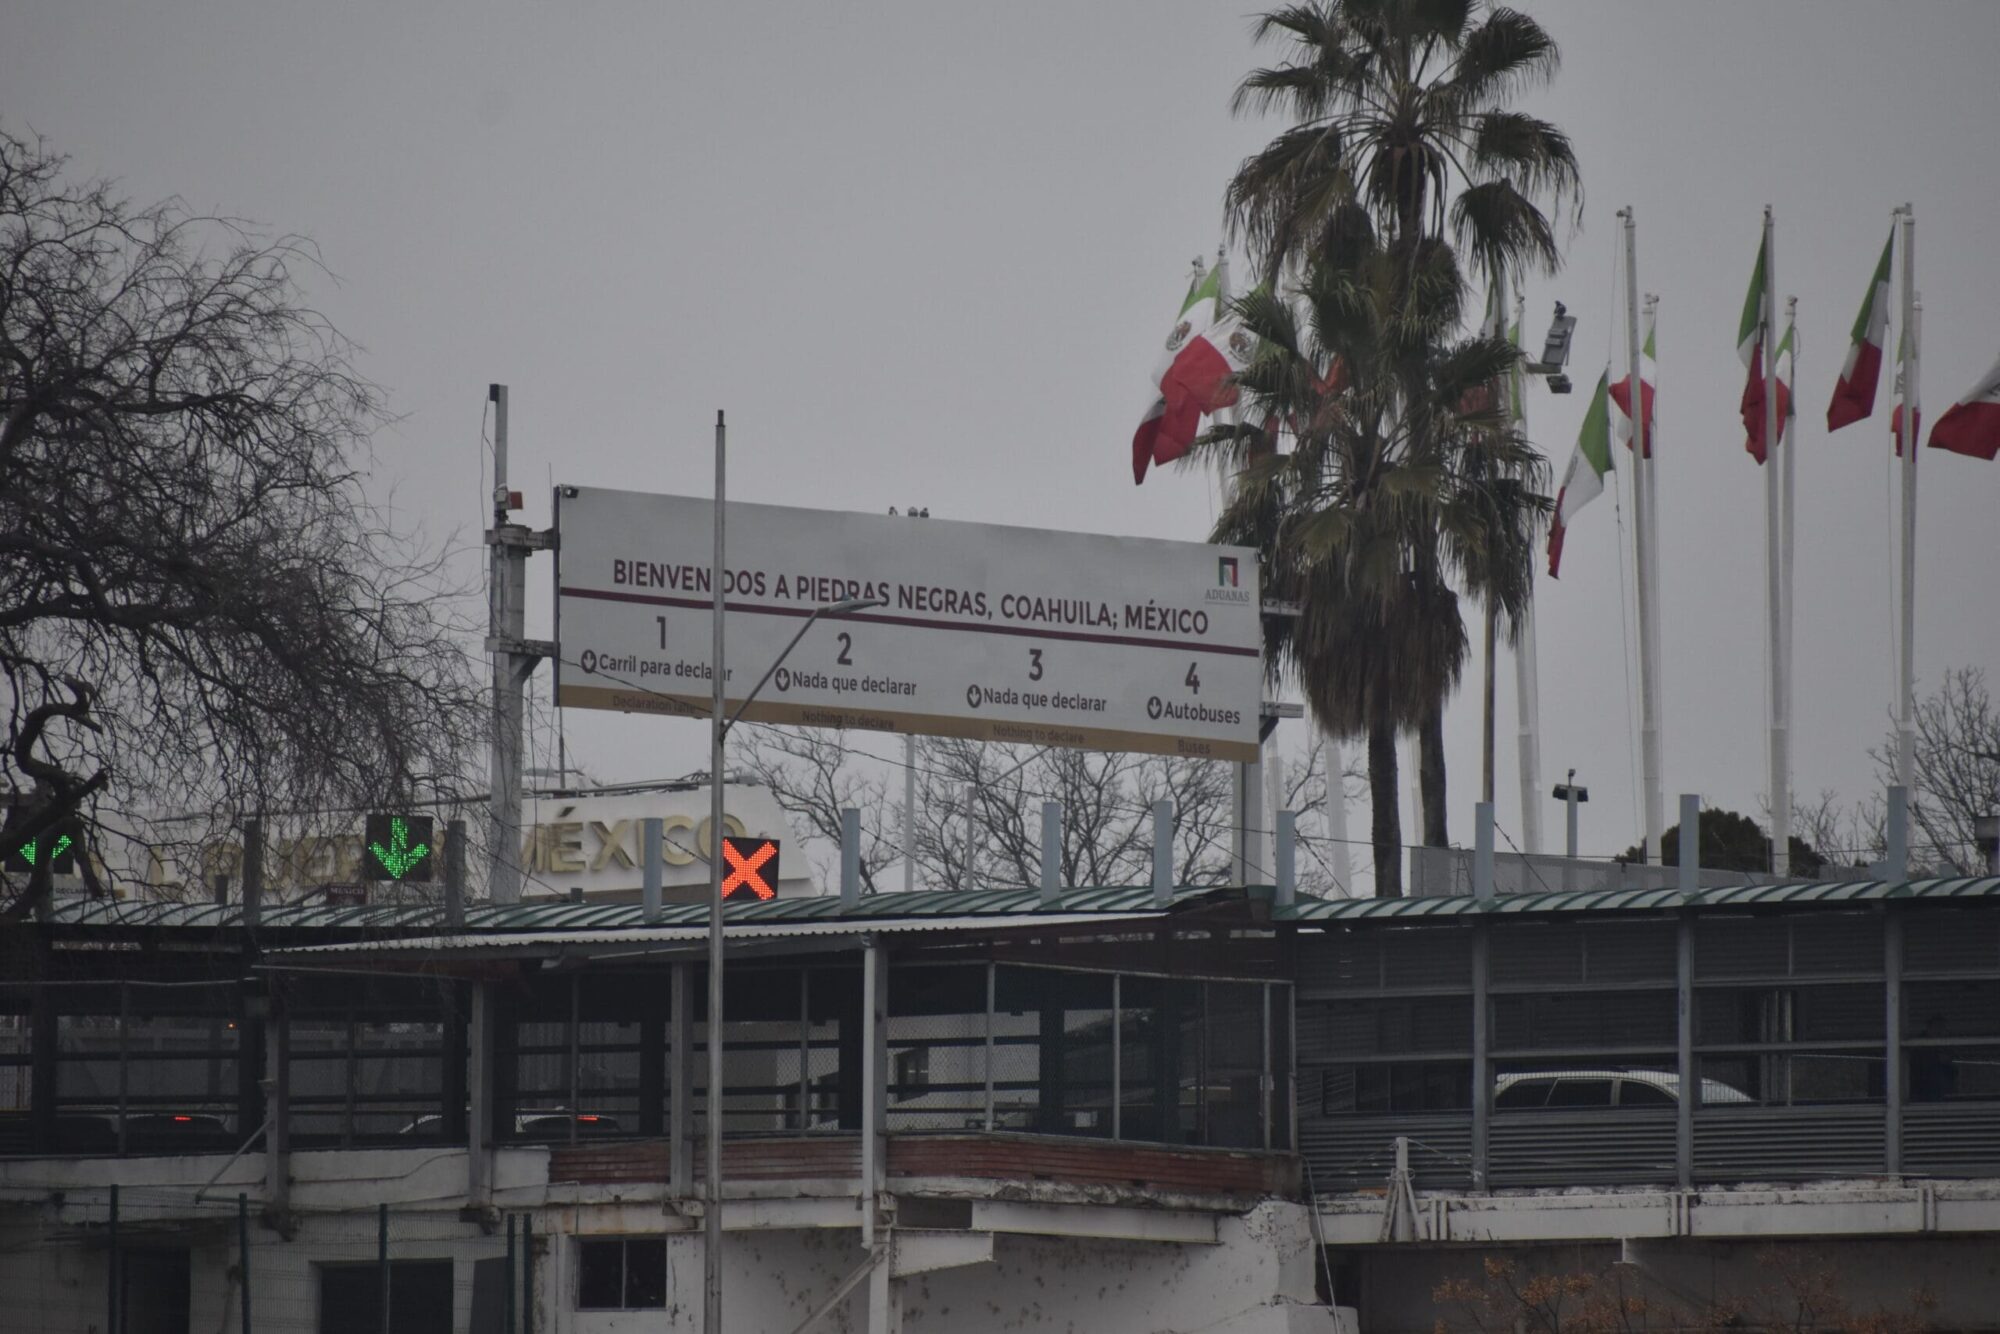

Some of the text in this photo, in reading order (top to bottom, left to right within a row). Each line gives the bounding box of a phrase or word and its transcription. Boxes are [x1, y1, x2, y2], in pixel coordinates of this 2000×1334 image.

[613, 559, 1209, 635] BIENVENDOS A PIEDRAS NEGRAS, COAHUILA; MÉXICO
[1205, 588, 1250, 602] ADUANAS
[656, 616, 667, 650] 1
[837, 632, 853, 666] 2
[599, 653, 732, 681] Carril para declar
[1028, 648, 1044, 681] 3
[792, 670, 917, 696] Nada que declarar
[1184, 662, 1201, 694] 4
[983, 688, 1107, 712] Nada que declarar
[1163, 701, 1241, 725] Autobuses
[801, 709, 843, 727] Nothing
[845, 714, 856, 726] to
[992, 723, 1086, 744] Nothing to declare
[1178, 738, 1211, 754] Buses
